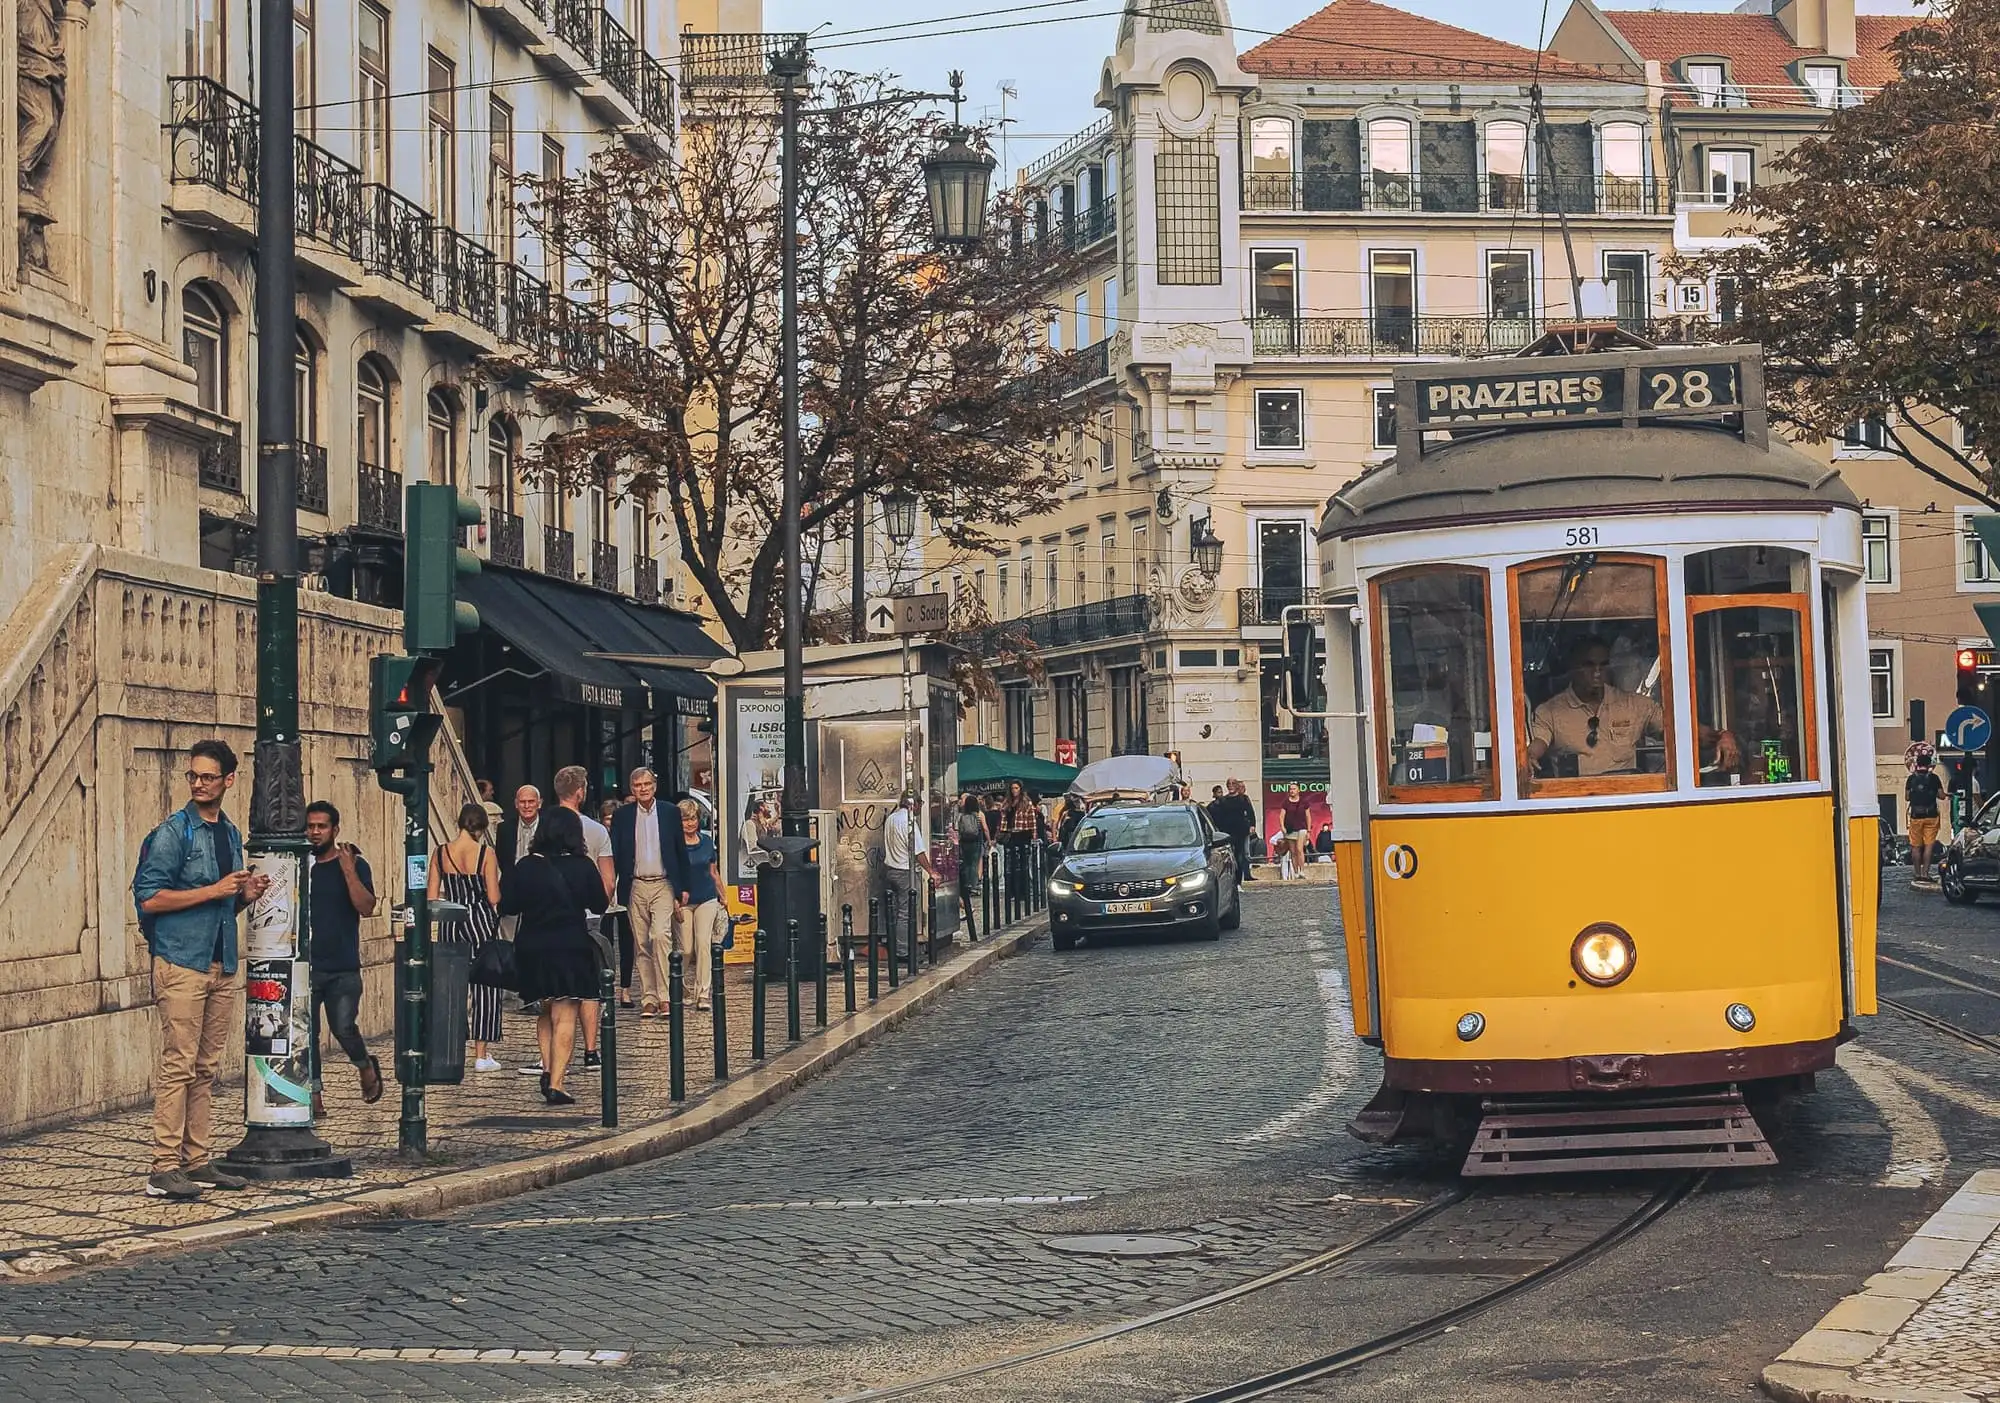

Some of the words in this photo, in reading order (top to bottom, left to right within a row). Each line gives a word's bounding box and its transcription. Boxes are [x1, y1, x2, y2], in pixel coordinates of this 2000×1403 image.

[1681, 287, 1700, 303] 15
[1428, 376, 1603, 411] PRAZERES
[1650, 371, 1714, 411] 28
[1566, 527, 1599, 546] 581
[920, 603, 945, 622] Sodré
[581, 684, 598, 703] VISTA
[600, 688, 622, 706] ALEGRE
[739, 704, 784, 713] EXPONOI
[1408, 750, 1424, 760] 28E
[1409, 767, 1423, 781] 01
